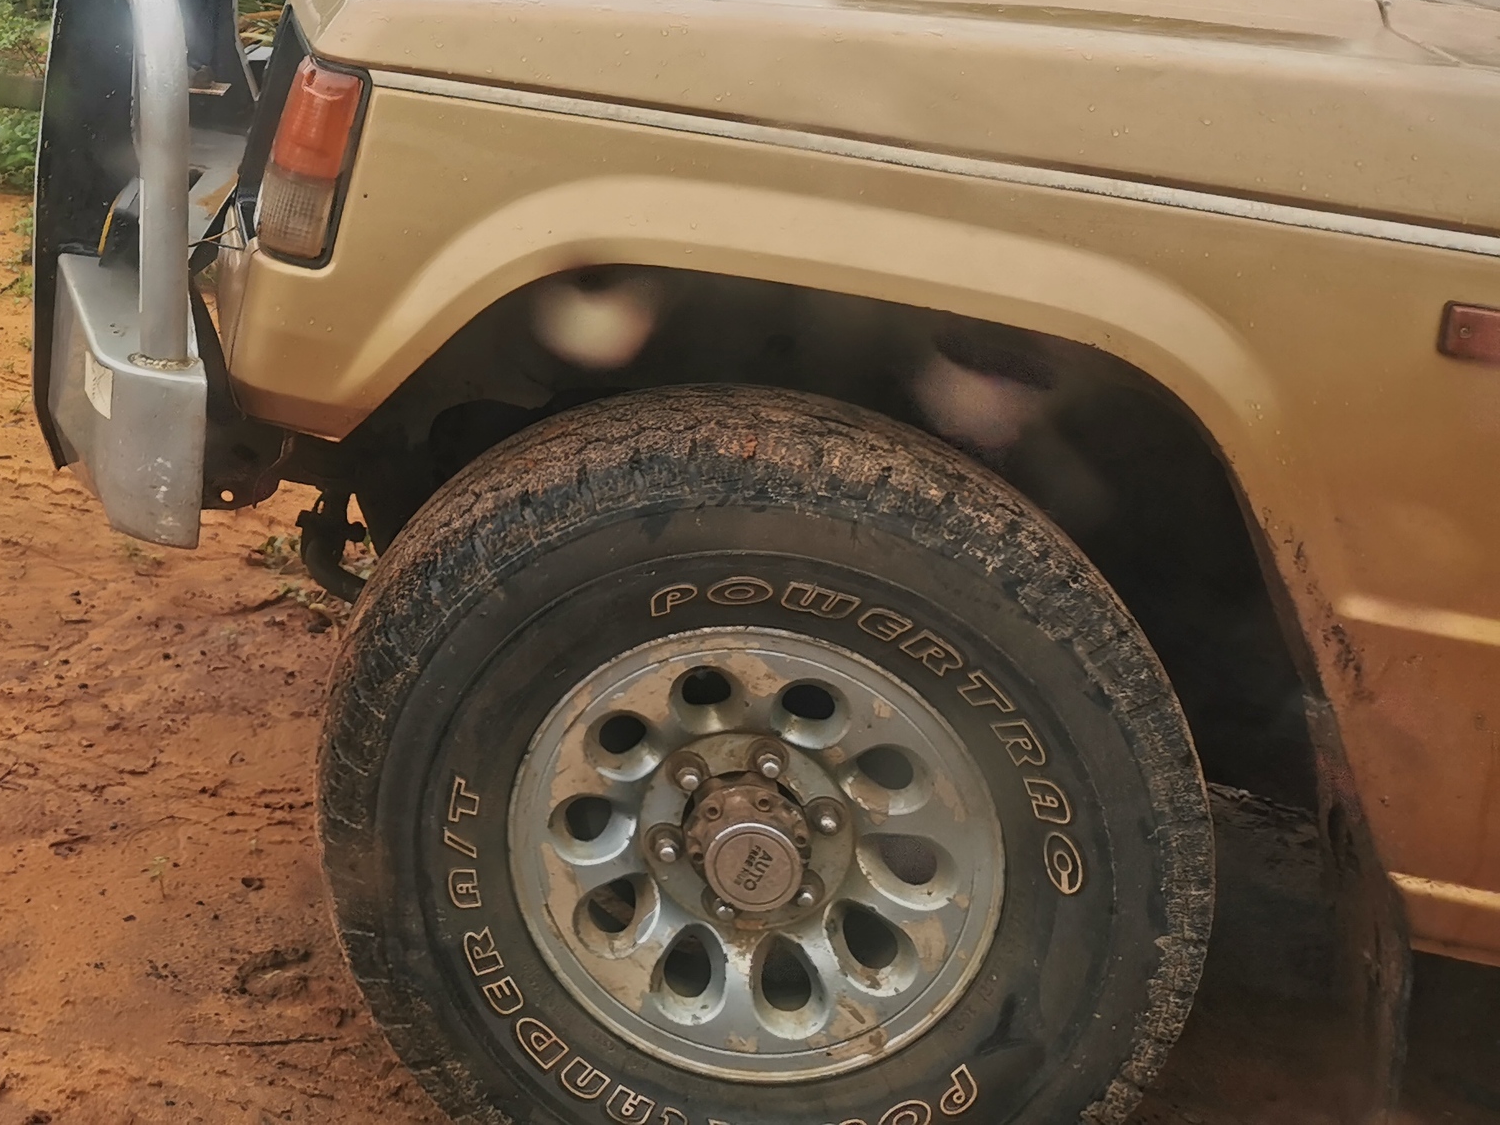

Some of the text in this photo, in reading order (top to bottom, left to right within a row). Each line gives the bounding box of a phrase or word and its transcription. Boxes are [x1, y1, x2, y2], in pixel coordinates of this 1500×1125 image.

[650, 576, 1083, 895] POWERTRAC
[444, 775, 482, 908] A/T
[743, 849, 773, 891] AUTO
[744, 844, 762, 868] FREE
